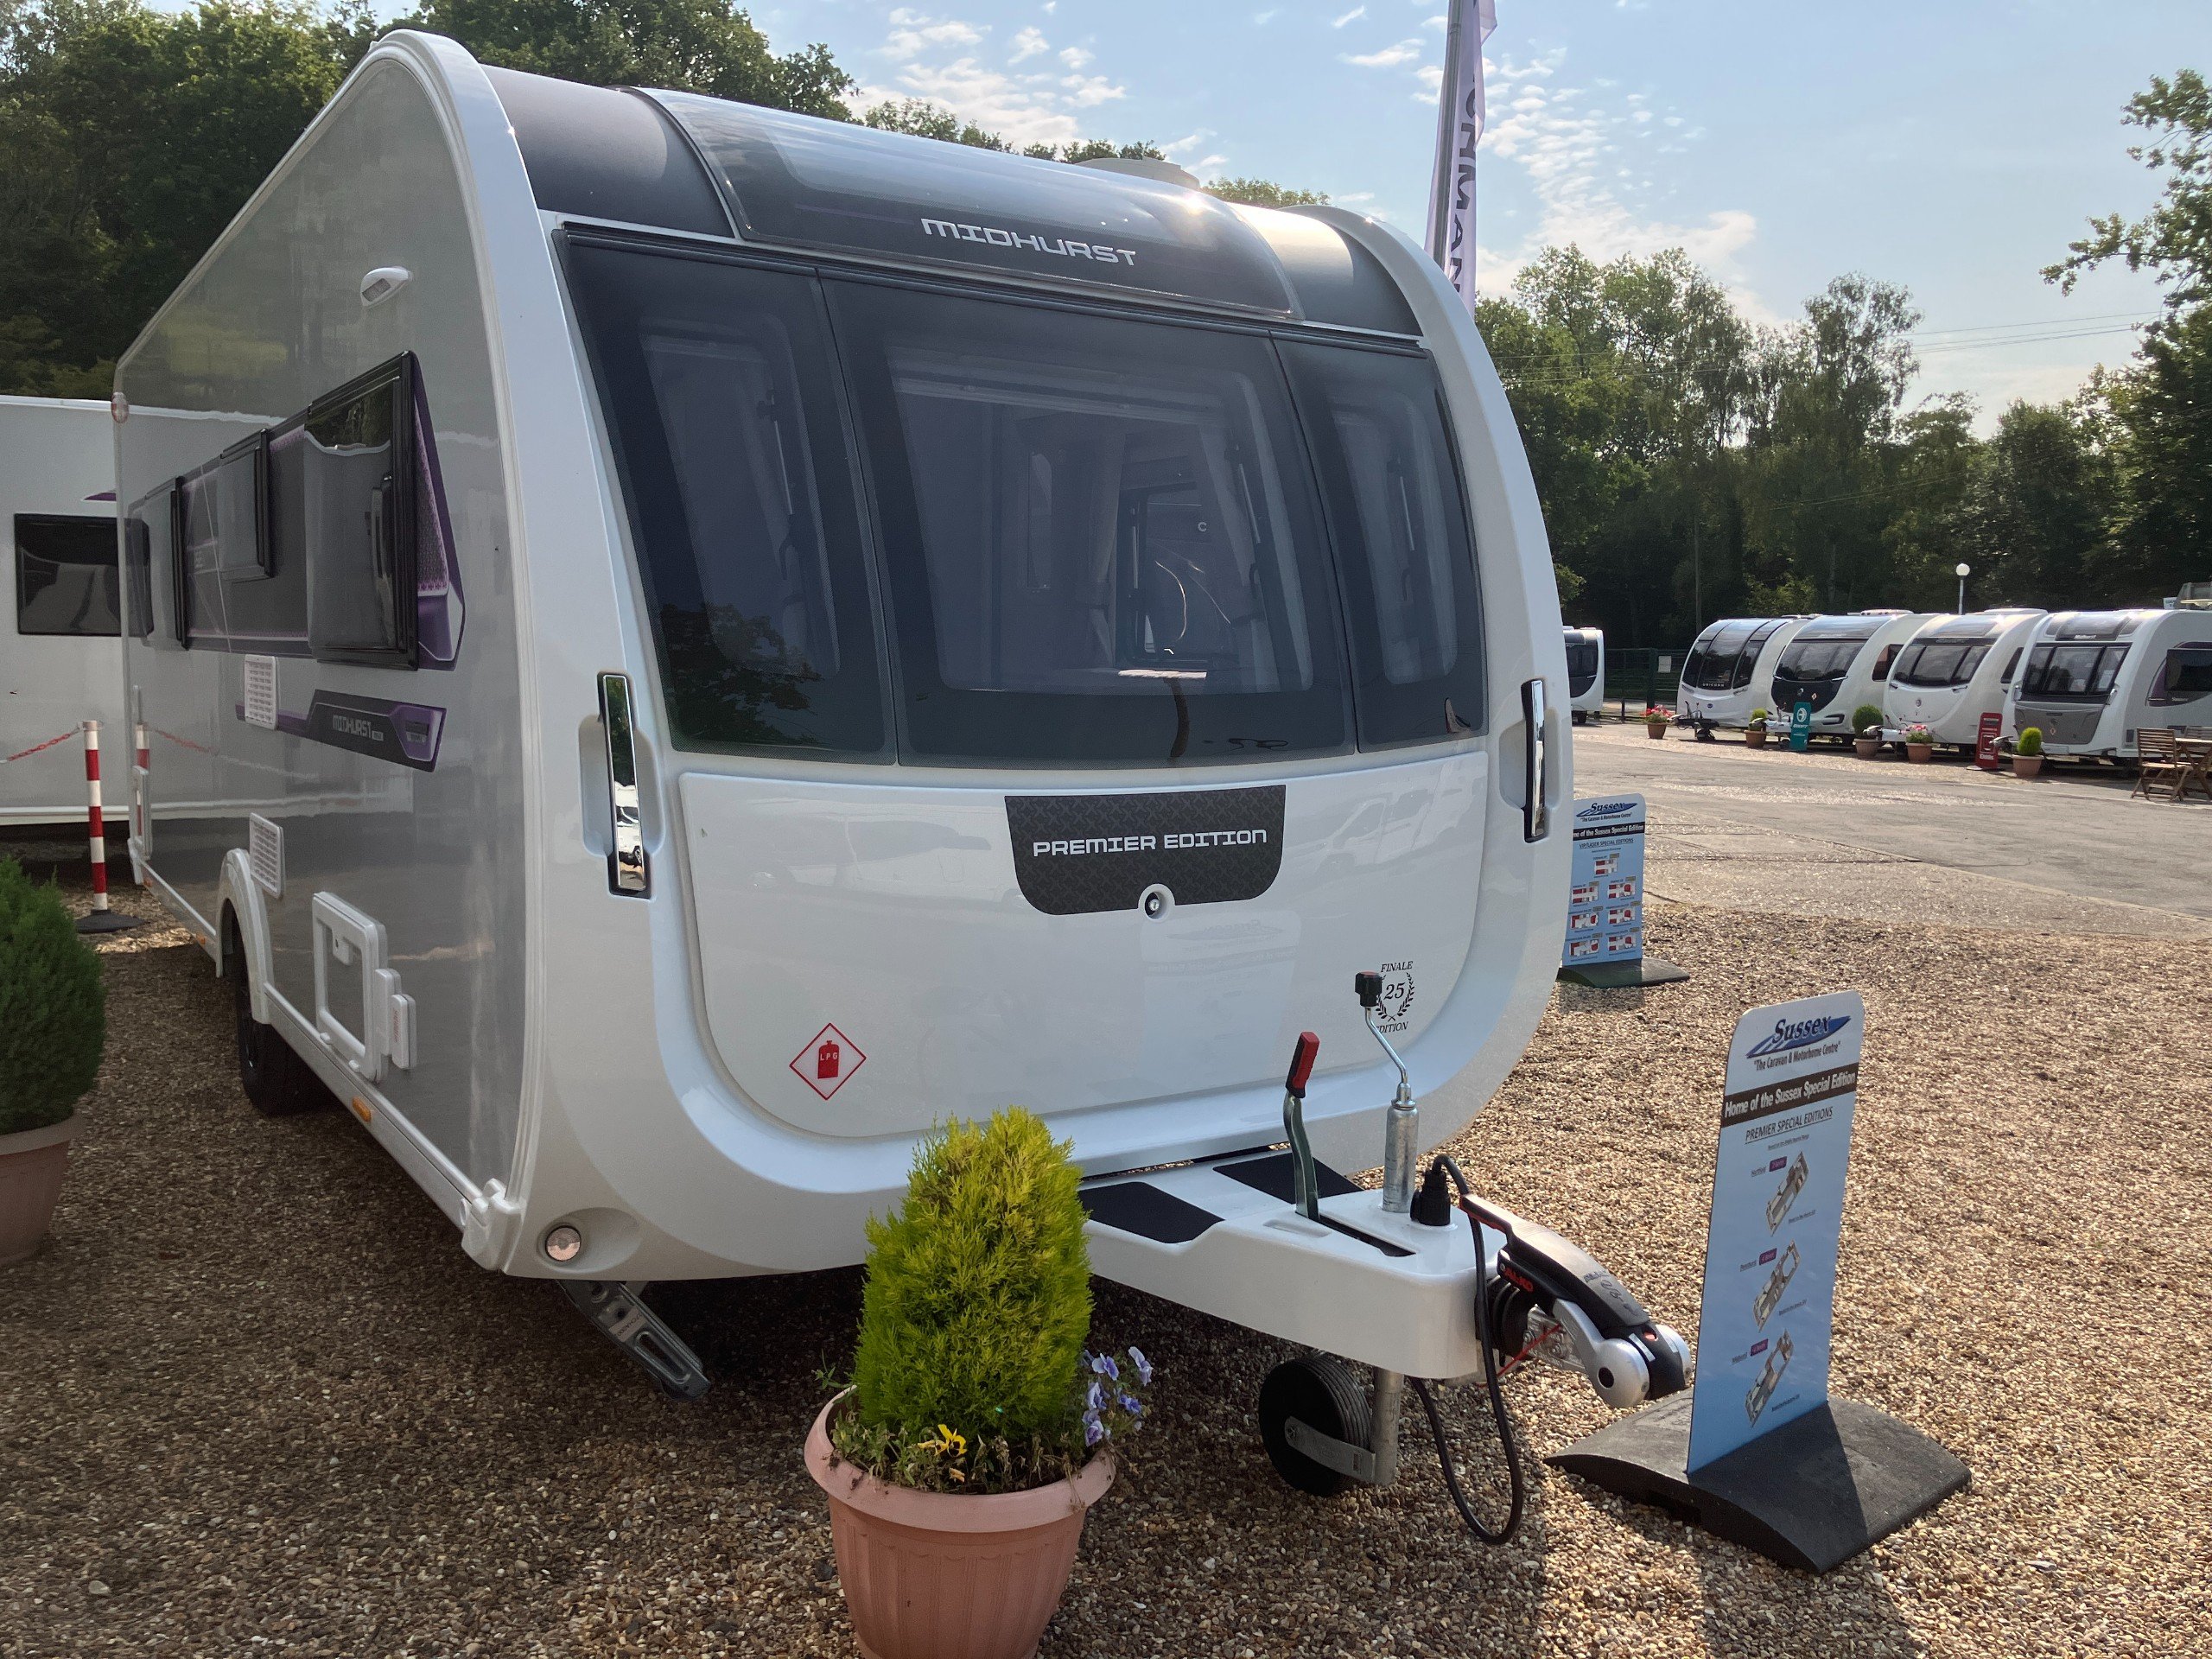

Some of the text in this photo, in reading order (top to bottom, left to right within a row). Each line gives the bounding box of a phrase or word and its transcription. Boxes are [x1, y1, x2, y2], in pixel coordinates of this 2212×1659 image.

[921, 218, 1136, 266] MIDHURST
[333, 715, 372, 739] MIDHURST
[1590, 802, 1625, 812] Sussex
[1611, 825, 1628, 834] Special
[1629, 823, 1643, 832] Edition
[1033, 830, 1267, 856] PREMIER EDITION
[1381, 961, 1414, 973] FINALE
[1383, 982, 1406, 1000] 25
[1772, 1016, 1831, 1044] Sussex
[1767, 1056, 1788, 1069] Caravan
[1794, 1047, 1821, 1062] Motorhome
[1725, 1071, 1856, 1118] Home of the Sussex Special Edition
[1745, 1106, 1833, 1141] PREMIER SPECIAL EDITIONS
